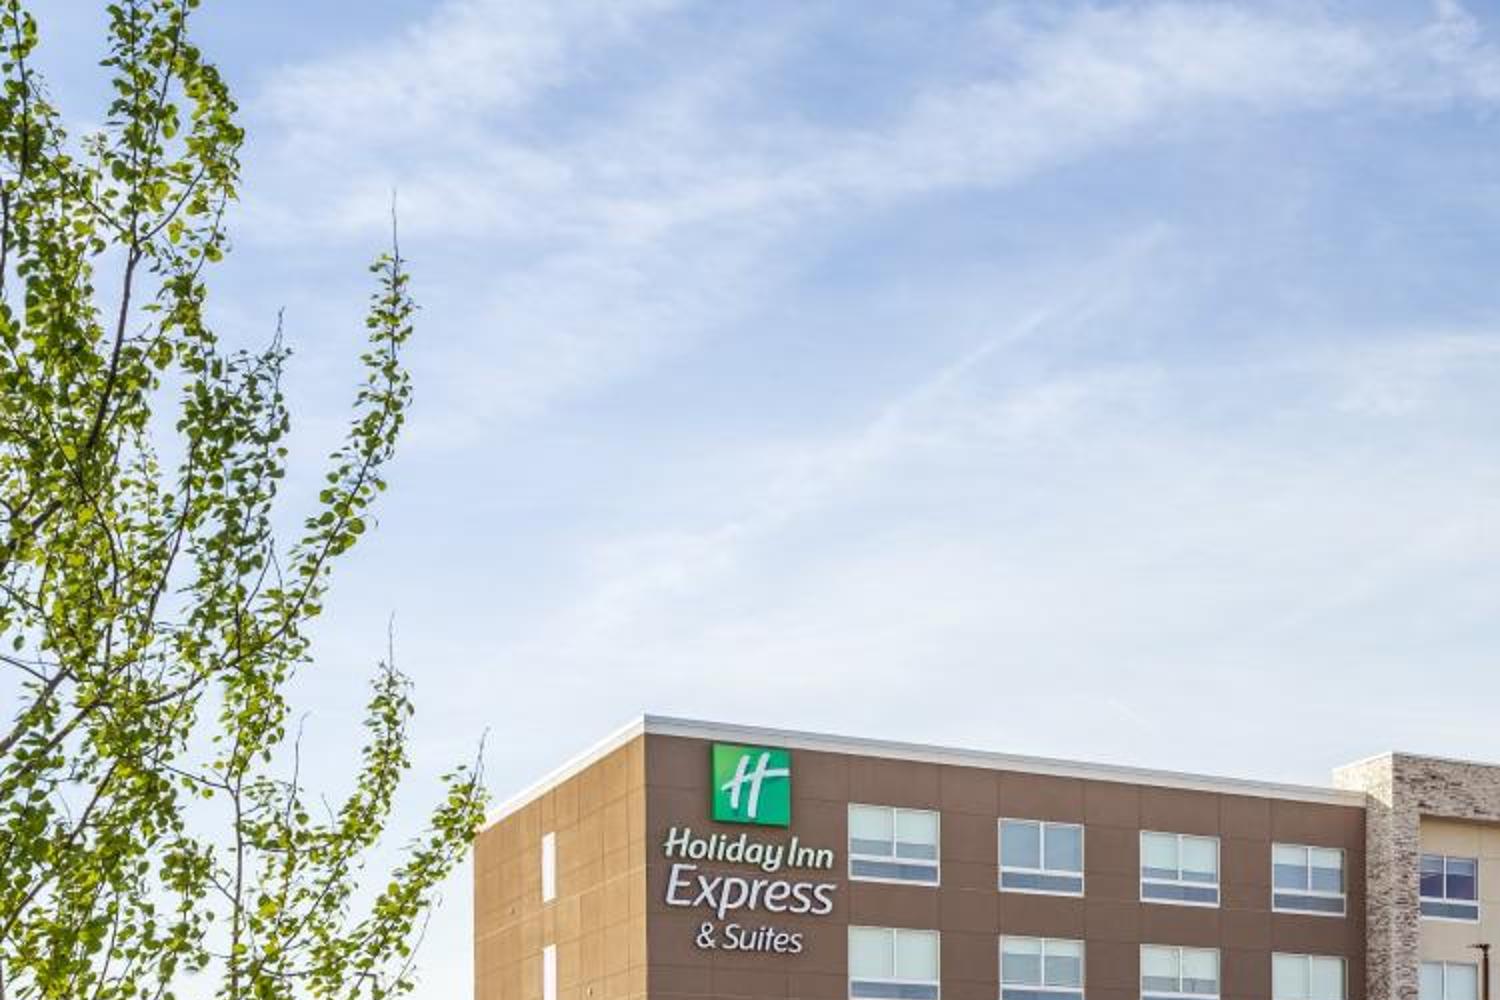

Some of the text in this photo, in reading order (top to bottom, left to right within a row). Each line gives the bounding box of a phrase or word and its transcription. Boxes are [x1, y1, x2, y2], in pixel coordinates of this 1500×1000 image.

[664, 827, 834, 872] Holiday Inn
[666, 863, 837, 920] Express
[696, 922, 804, 953] & Suites
